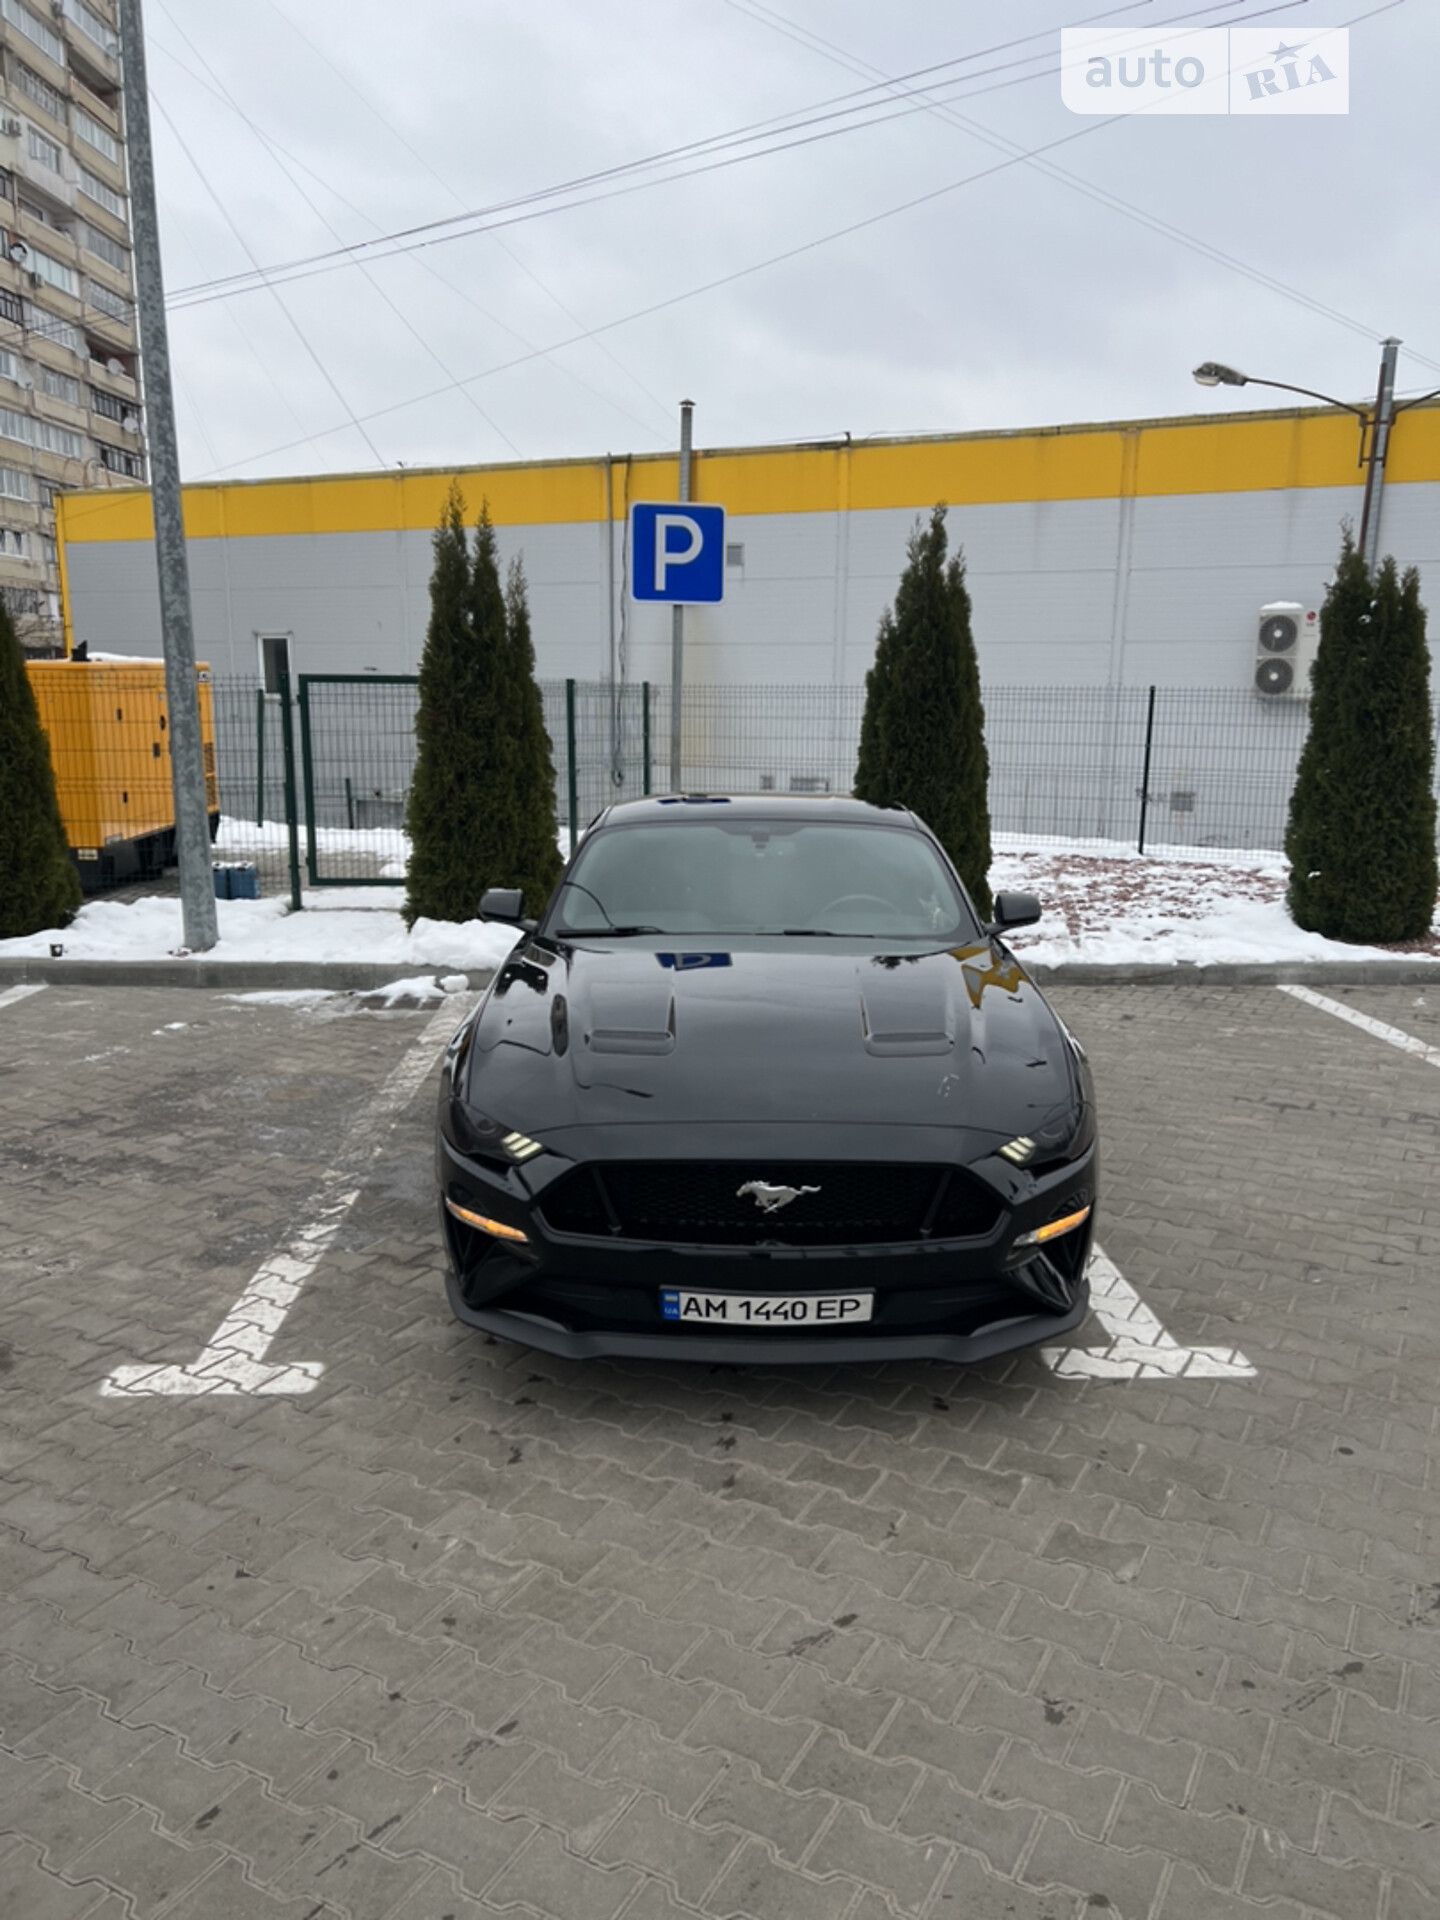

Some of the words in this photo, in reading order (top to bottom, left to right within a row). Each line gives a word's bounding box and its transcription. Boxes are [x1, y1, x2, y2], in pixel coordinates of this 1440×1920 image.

[655, 513, 703, 591] P
[682, 1297, 727, 1319] AM
[738, 1300, 808, 1321] 1440
[816, 1299, 861, 1320] EP
